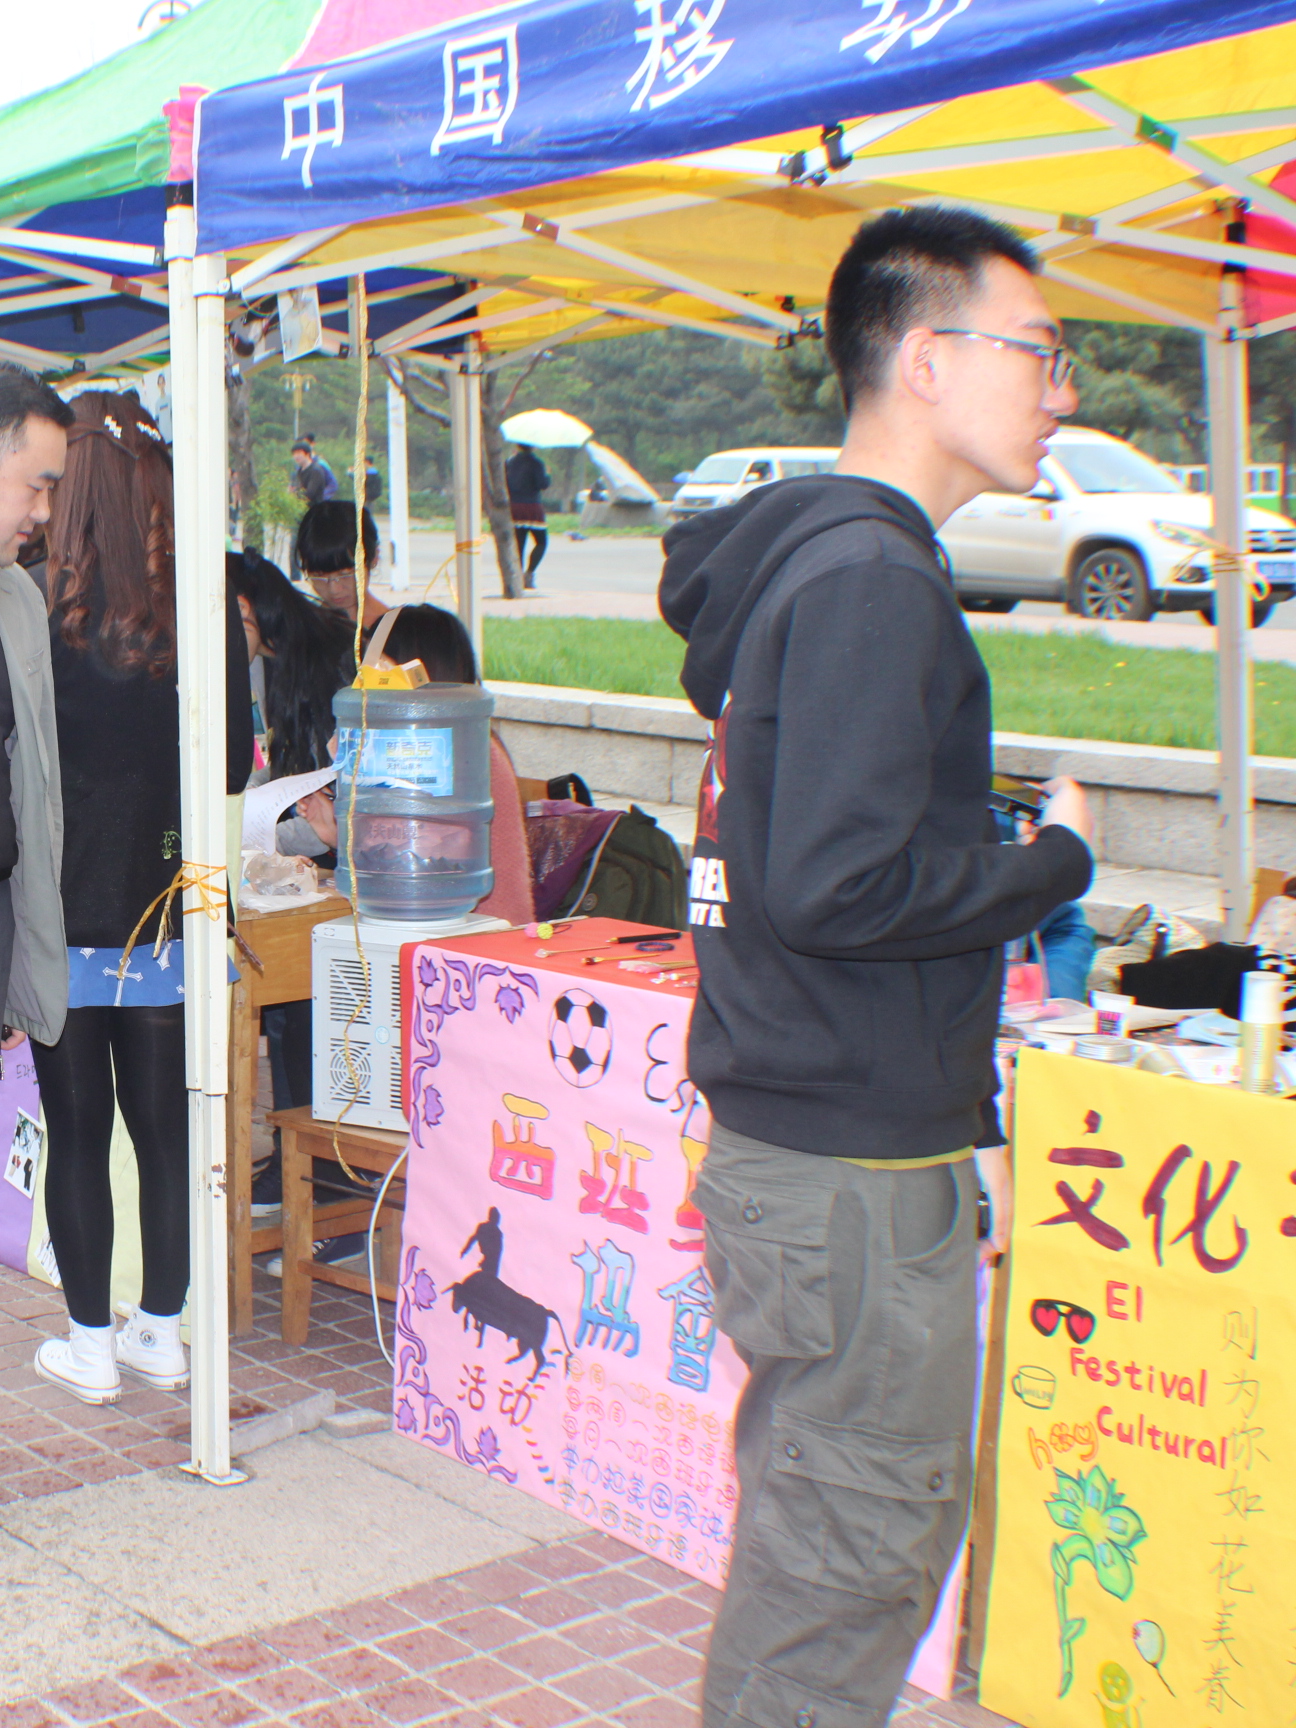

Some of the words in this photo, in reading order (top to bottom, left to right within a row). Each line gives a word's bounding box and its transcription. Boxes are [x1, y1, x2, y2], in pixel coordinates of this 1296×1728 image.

[1031, 1110, 1296, 1273] 文化
[1105, 1280, 1144, 1323] El
[457, 1363, 536, 1427] 活动
[1070, 1346, 1210, 1408] Festival
[1096, 1405, 1230, 1470] Cultural
